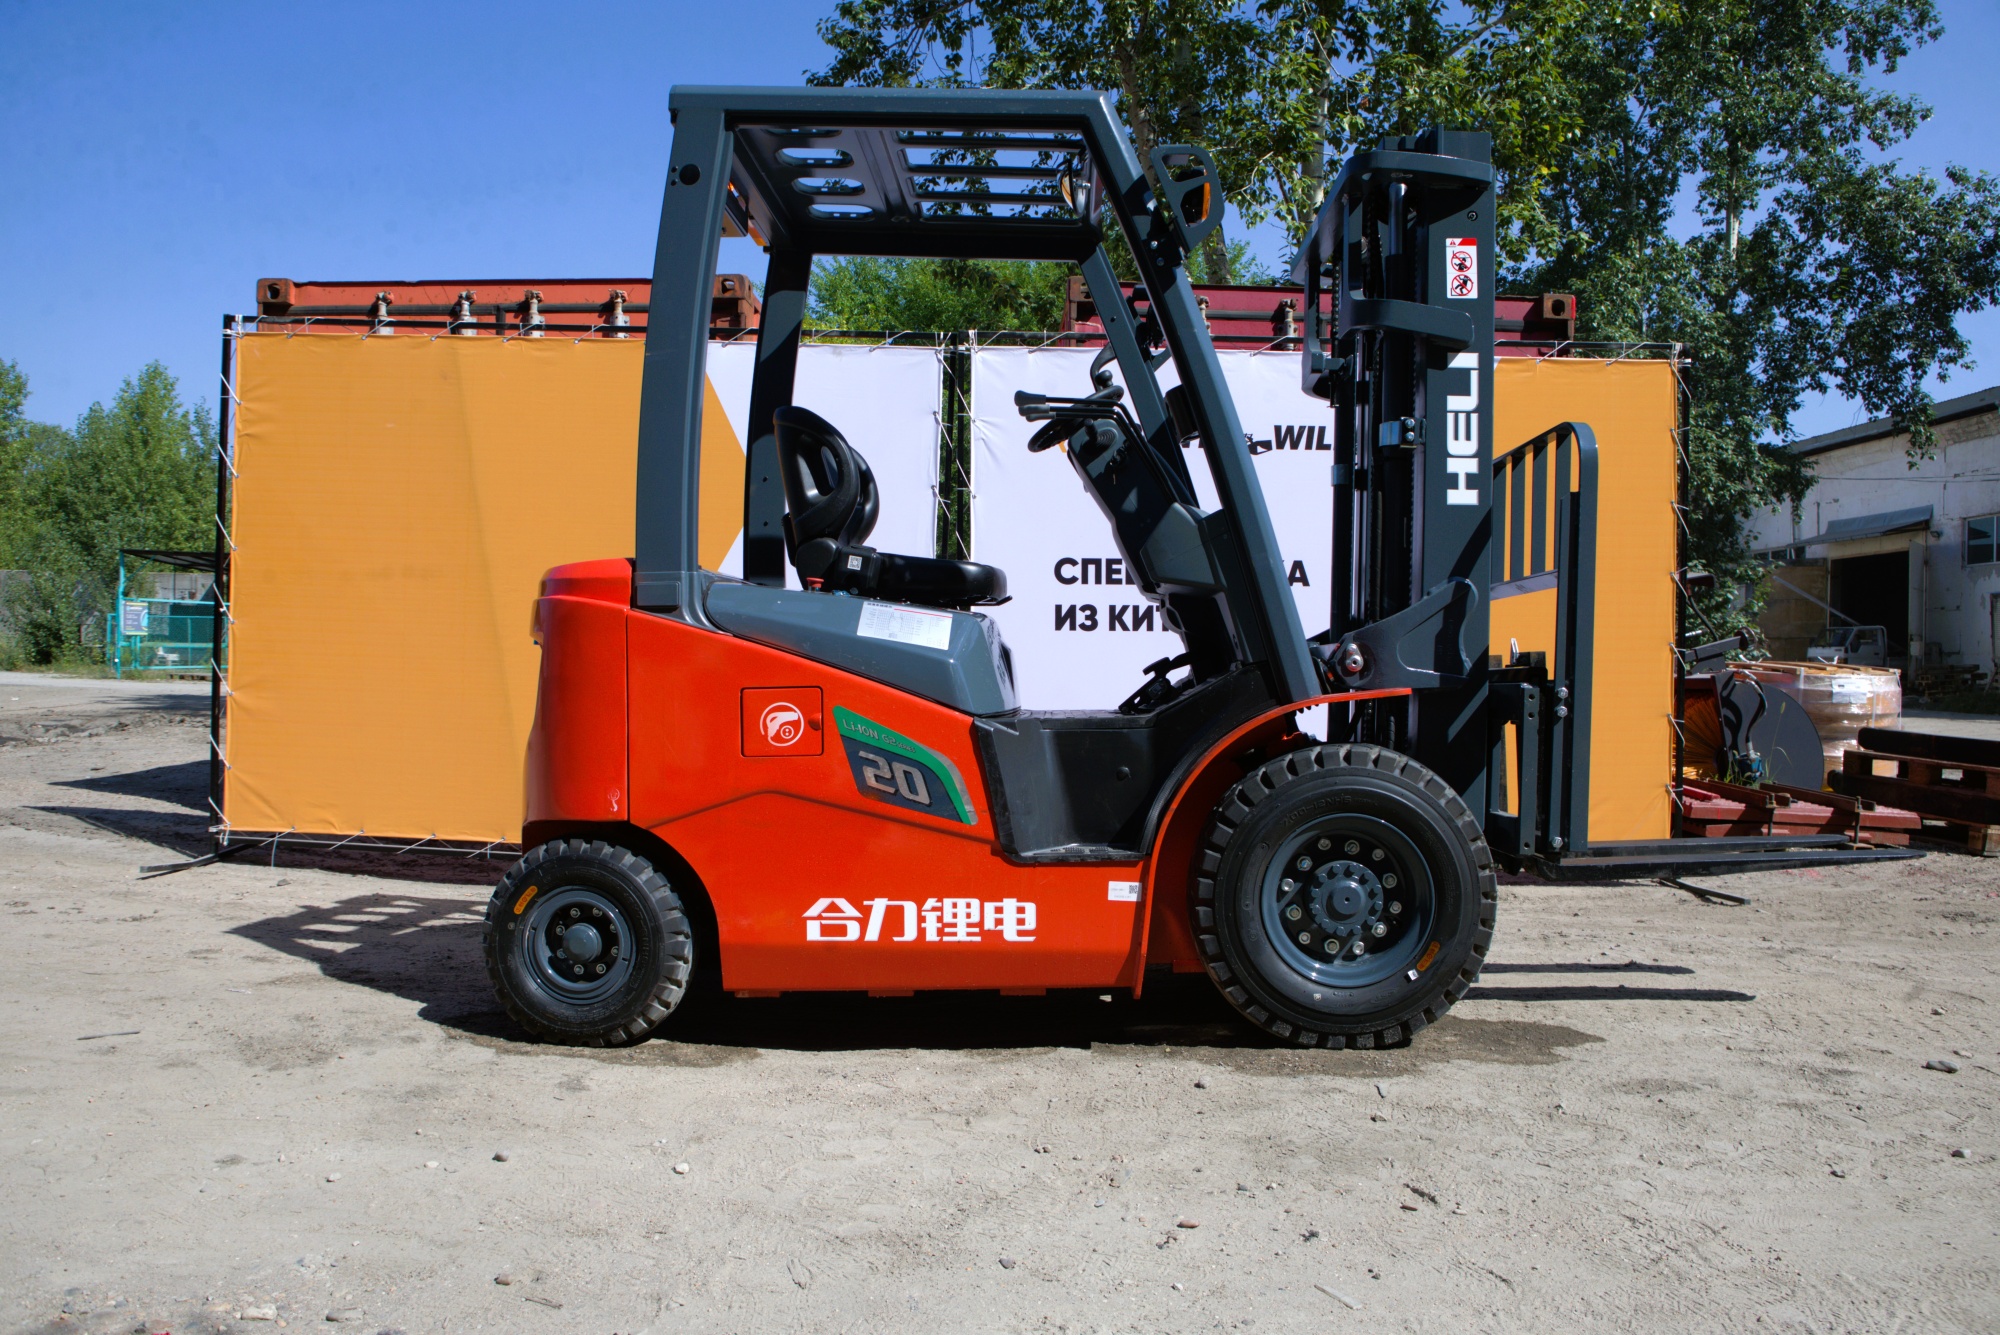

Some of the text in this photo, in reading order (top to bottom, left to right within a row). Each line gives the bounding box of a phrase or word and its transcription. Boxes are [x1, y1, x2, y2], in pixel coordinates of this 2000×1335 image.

[1274, 425, 1335, 451] WIL
[1446, 352, 1479, 506] HELI
[1054, 604, 1170, 632] ИЗ КИ
[881, 734, 897, 746] G2
[858, 751, 931, 805] 20
[801, 897, 1037, 943] 合力锂电
